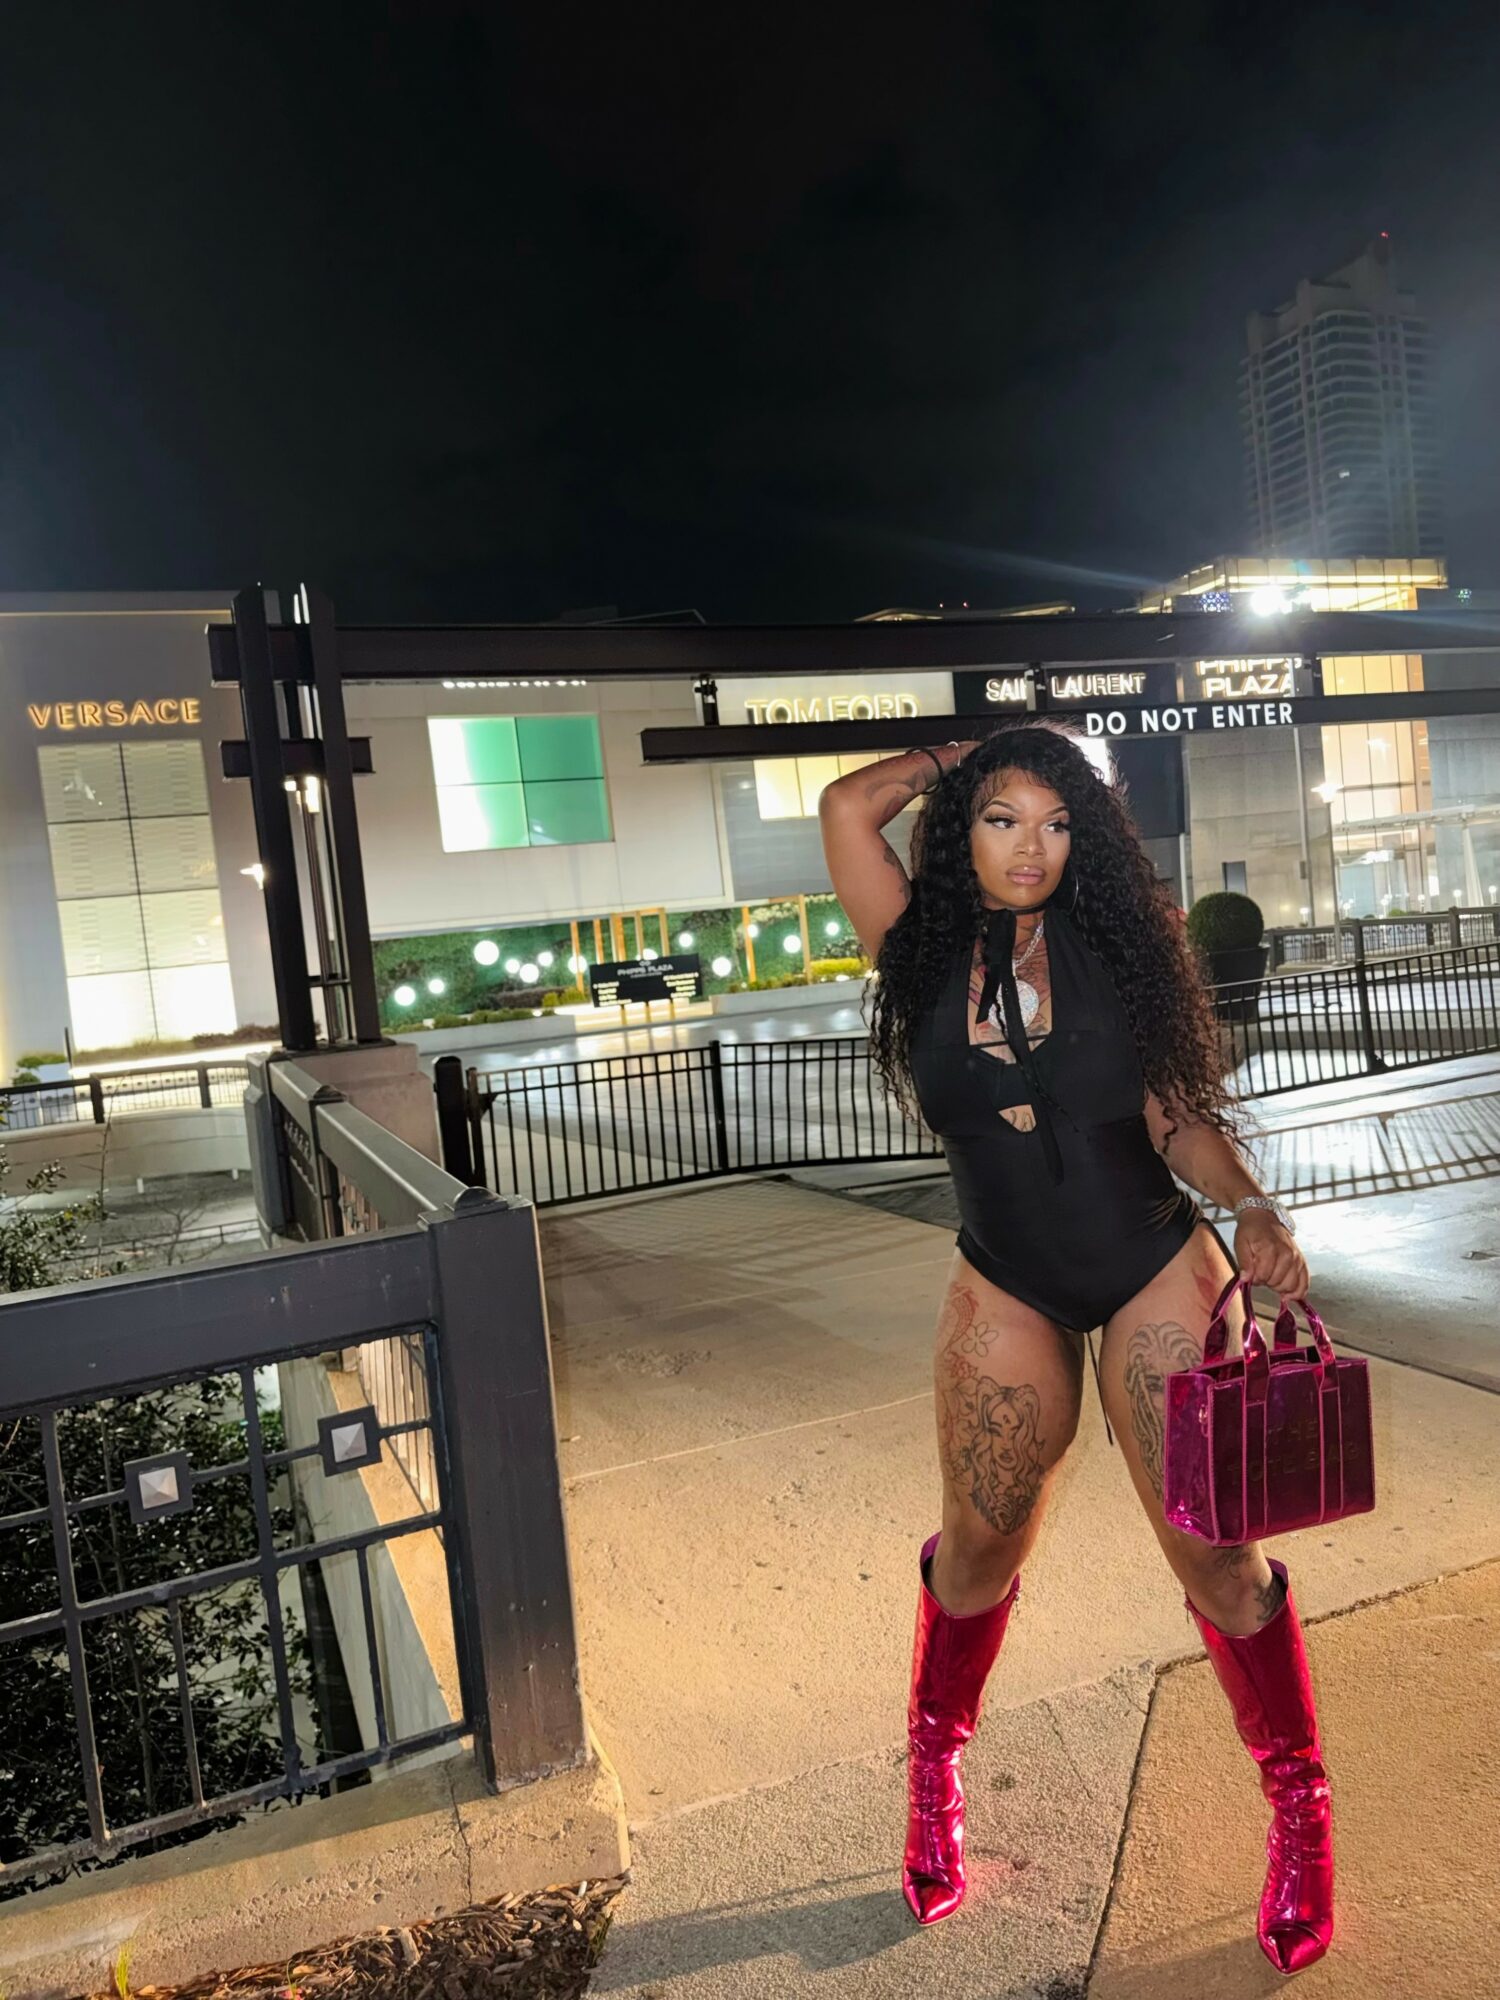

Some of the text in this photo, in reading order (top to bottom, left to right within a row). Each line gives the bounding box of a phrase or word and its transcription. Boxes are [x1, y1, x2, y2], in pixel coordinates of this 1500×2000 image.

[986, 671, 1146, 702] SAI LAURENT
[1204, 674, 1297, 699] PLAZA
[28, 697, 201, 730] VERSACE
[744, 693, 919, 725] TOM FORD
[1086, 702, 1294, 737] DO NOT ENTER
[1267, 1417, 1318, 1445] THE
